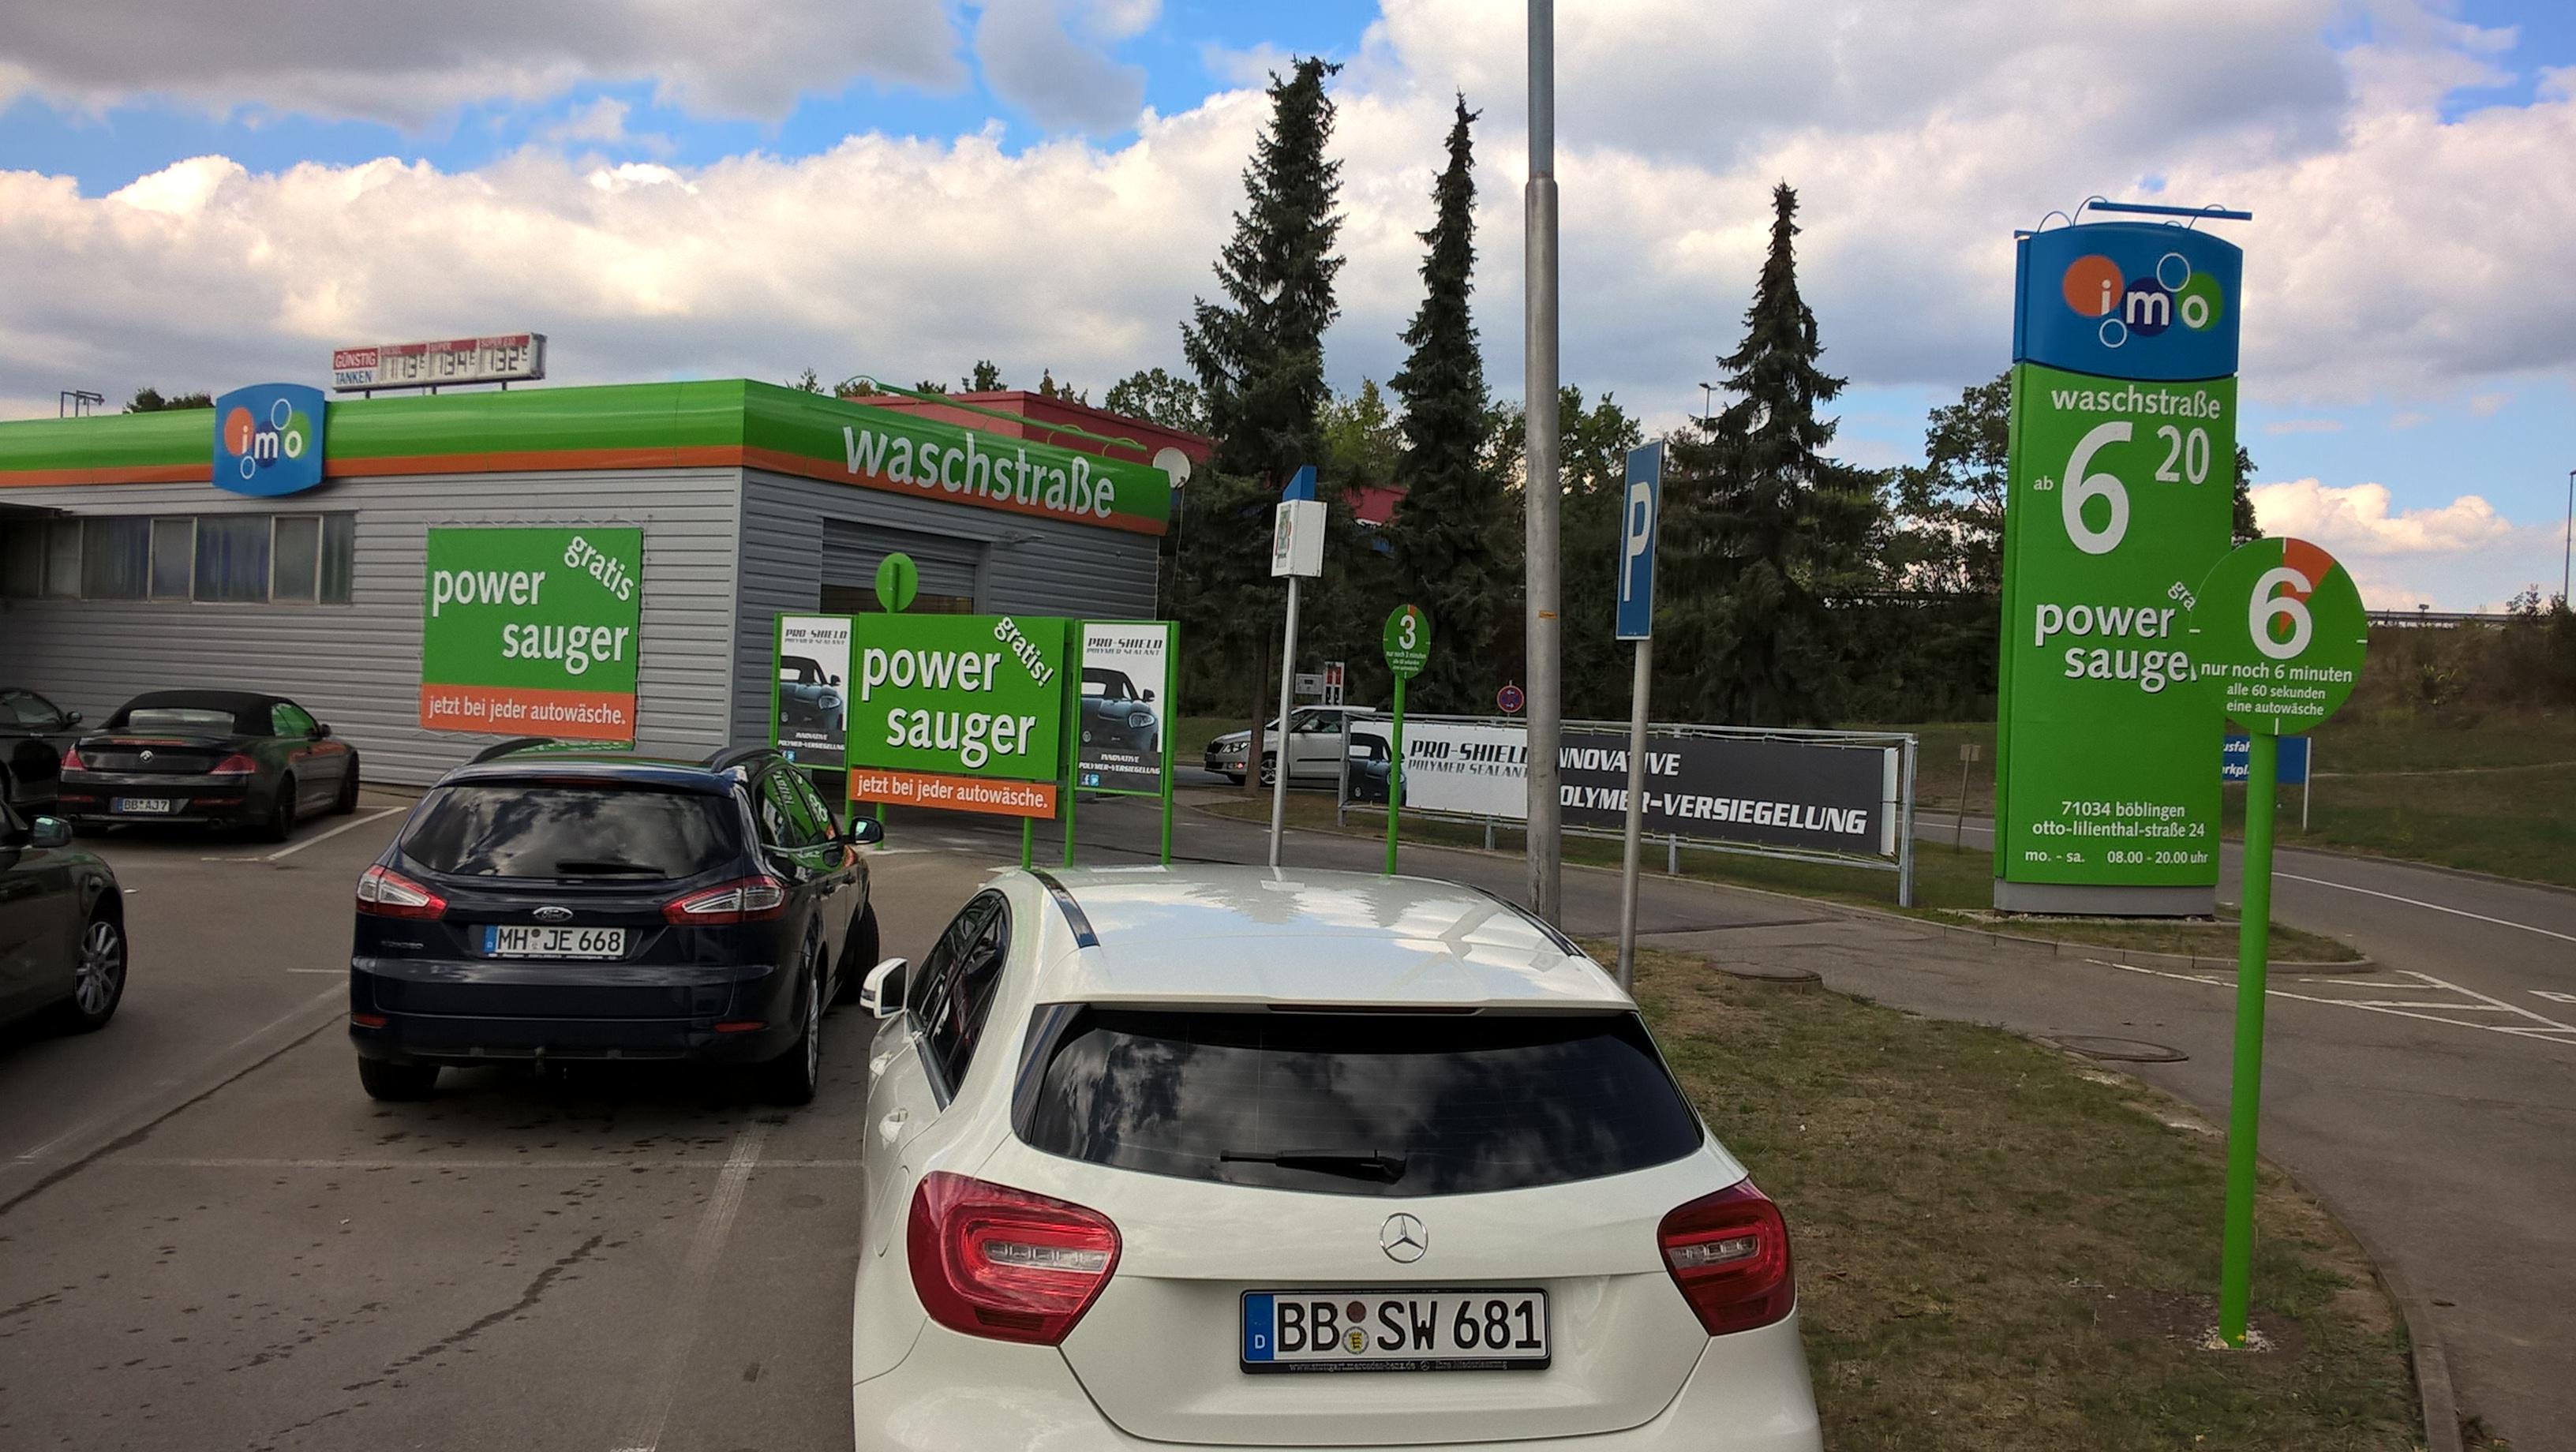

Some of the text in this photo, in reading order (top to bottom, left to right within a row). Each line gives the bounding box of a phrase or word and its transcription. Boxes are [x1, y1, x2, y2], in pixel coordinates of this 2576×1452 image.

[2101, 279, 2209, 329] imo
[335, 351, 376, 369] GÜNSTIG
[335, 370, 373, 385] TANKEN
[2051, 385, 2220, 419] waschstraße
[242, 425, 302, 458] imo
[843, 426, 1115, 518] waschstraße
[2033, 421, 2210, 555] ab 6 20
[1623, 481, 1652, 601] P
[564, 536, 634, 601] gratis
[432, 570, 546, 617] power
[2167, 581, 2196, 612] gra
[2035, 603, 2176, 647] power
[2248, 567, 2312, 660] 6
[502, 623, 629, 675] sauger
[1398, 615, 1416, 649] 3
[993, 616, 1054, 687] gratis!
[861, 648, 1002, 702] power
[2201, 662, 2353, 683] nur noch 6 minuten
[2226, 683, 2326, 699] alle 60 sekunden
[2226, 700, 2324, 716] eine autowäsche
[429, 695, 626, 724] jetzt bei jeder autowäsche.
[886, 707, 1036, 769] sauger
[857, 775, 1048, 808] jetzt bei jeder autowäsche.
[2061, 801, 2185, 821] 71034 böblingen
[2032, 821, 2205, 837] otto-lilienthal-straße 24
[2025, 851, 2052, 863] mo.
[2066, 852, 2085, 863] sa.
[2107, 851, 2144, 863] 08.00
[2155, 851, 2188, 864] 20.00
[2191, 851, 2209, 863] uhr
[498, 929, 528, 949] MH
[543, 930, 573, 951] JE
[578, 930, 621, 952] 668
[1255, 1300, 1541, 1352] D BB SW 681
